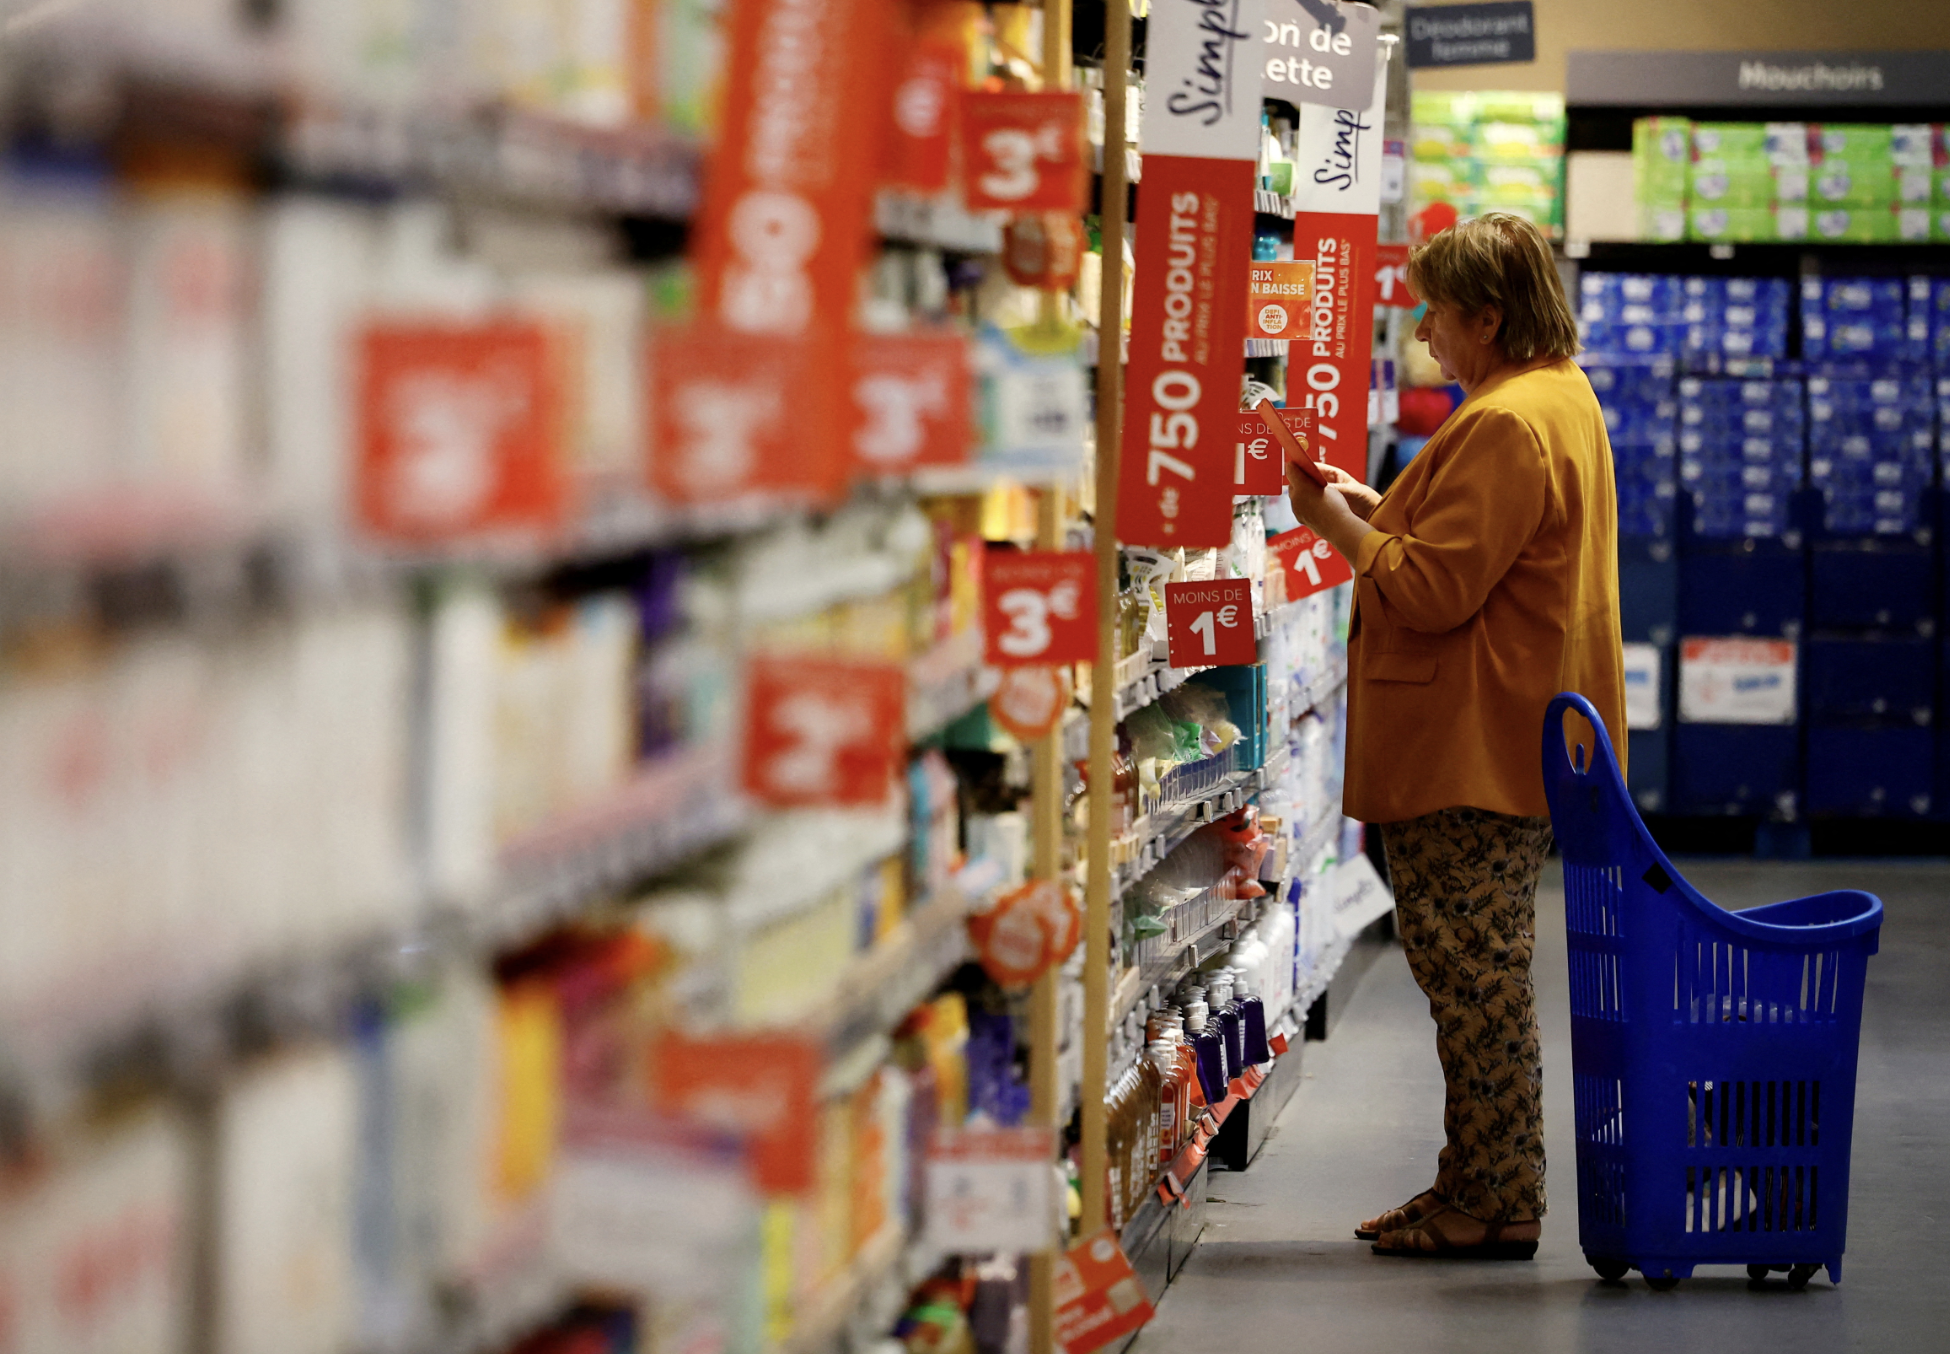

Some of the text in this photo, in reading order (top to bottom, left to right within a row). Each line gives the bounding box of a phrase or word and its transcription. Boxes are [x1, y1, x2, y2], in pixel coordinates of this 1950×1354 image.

[1263, 20, 1352, 55] on de
[1262, 56, 1333, 90] ette
[1739, 60, 1884, 91] Mouchoirs
[1314, 109, 1371, 191] Simp
[1161, 192, 1199, 362] PRODUITS
[1251, 283, 1305, 295] N BAISSE
[1252, 270, 1272, 281] RIX
[1338, 267, 1349, 296] PLUS
[1313, 238, 1337, 357] PRODUITS
[1337, 299, 1348, 312] LE
[1336, 314, 1346, 340] PRIX
[1335, 342, 1345, 359] AU
[1147, 370, 1201, 486] 750
[1257, 423, 1273, 434] DE
[1295, 418, 1311, 429] DE
[1293, 538, 1332, 586] 1€
[1174, 589, 1242, 604] MOINS DE
[998, 579, 1081, 656] 3€
[1188, 605, 1238, 655] 1€
